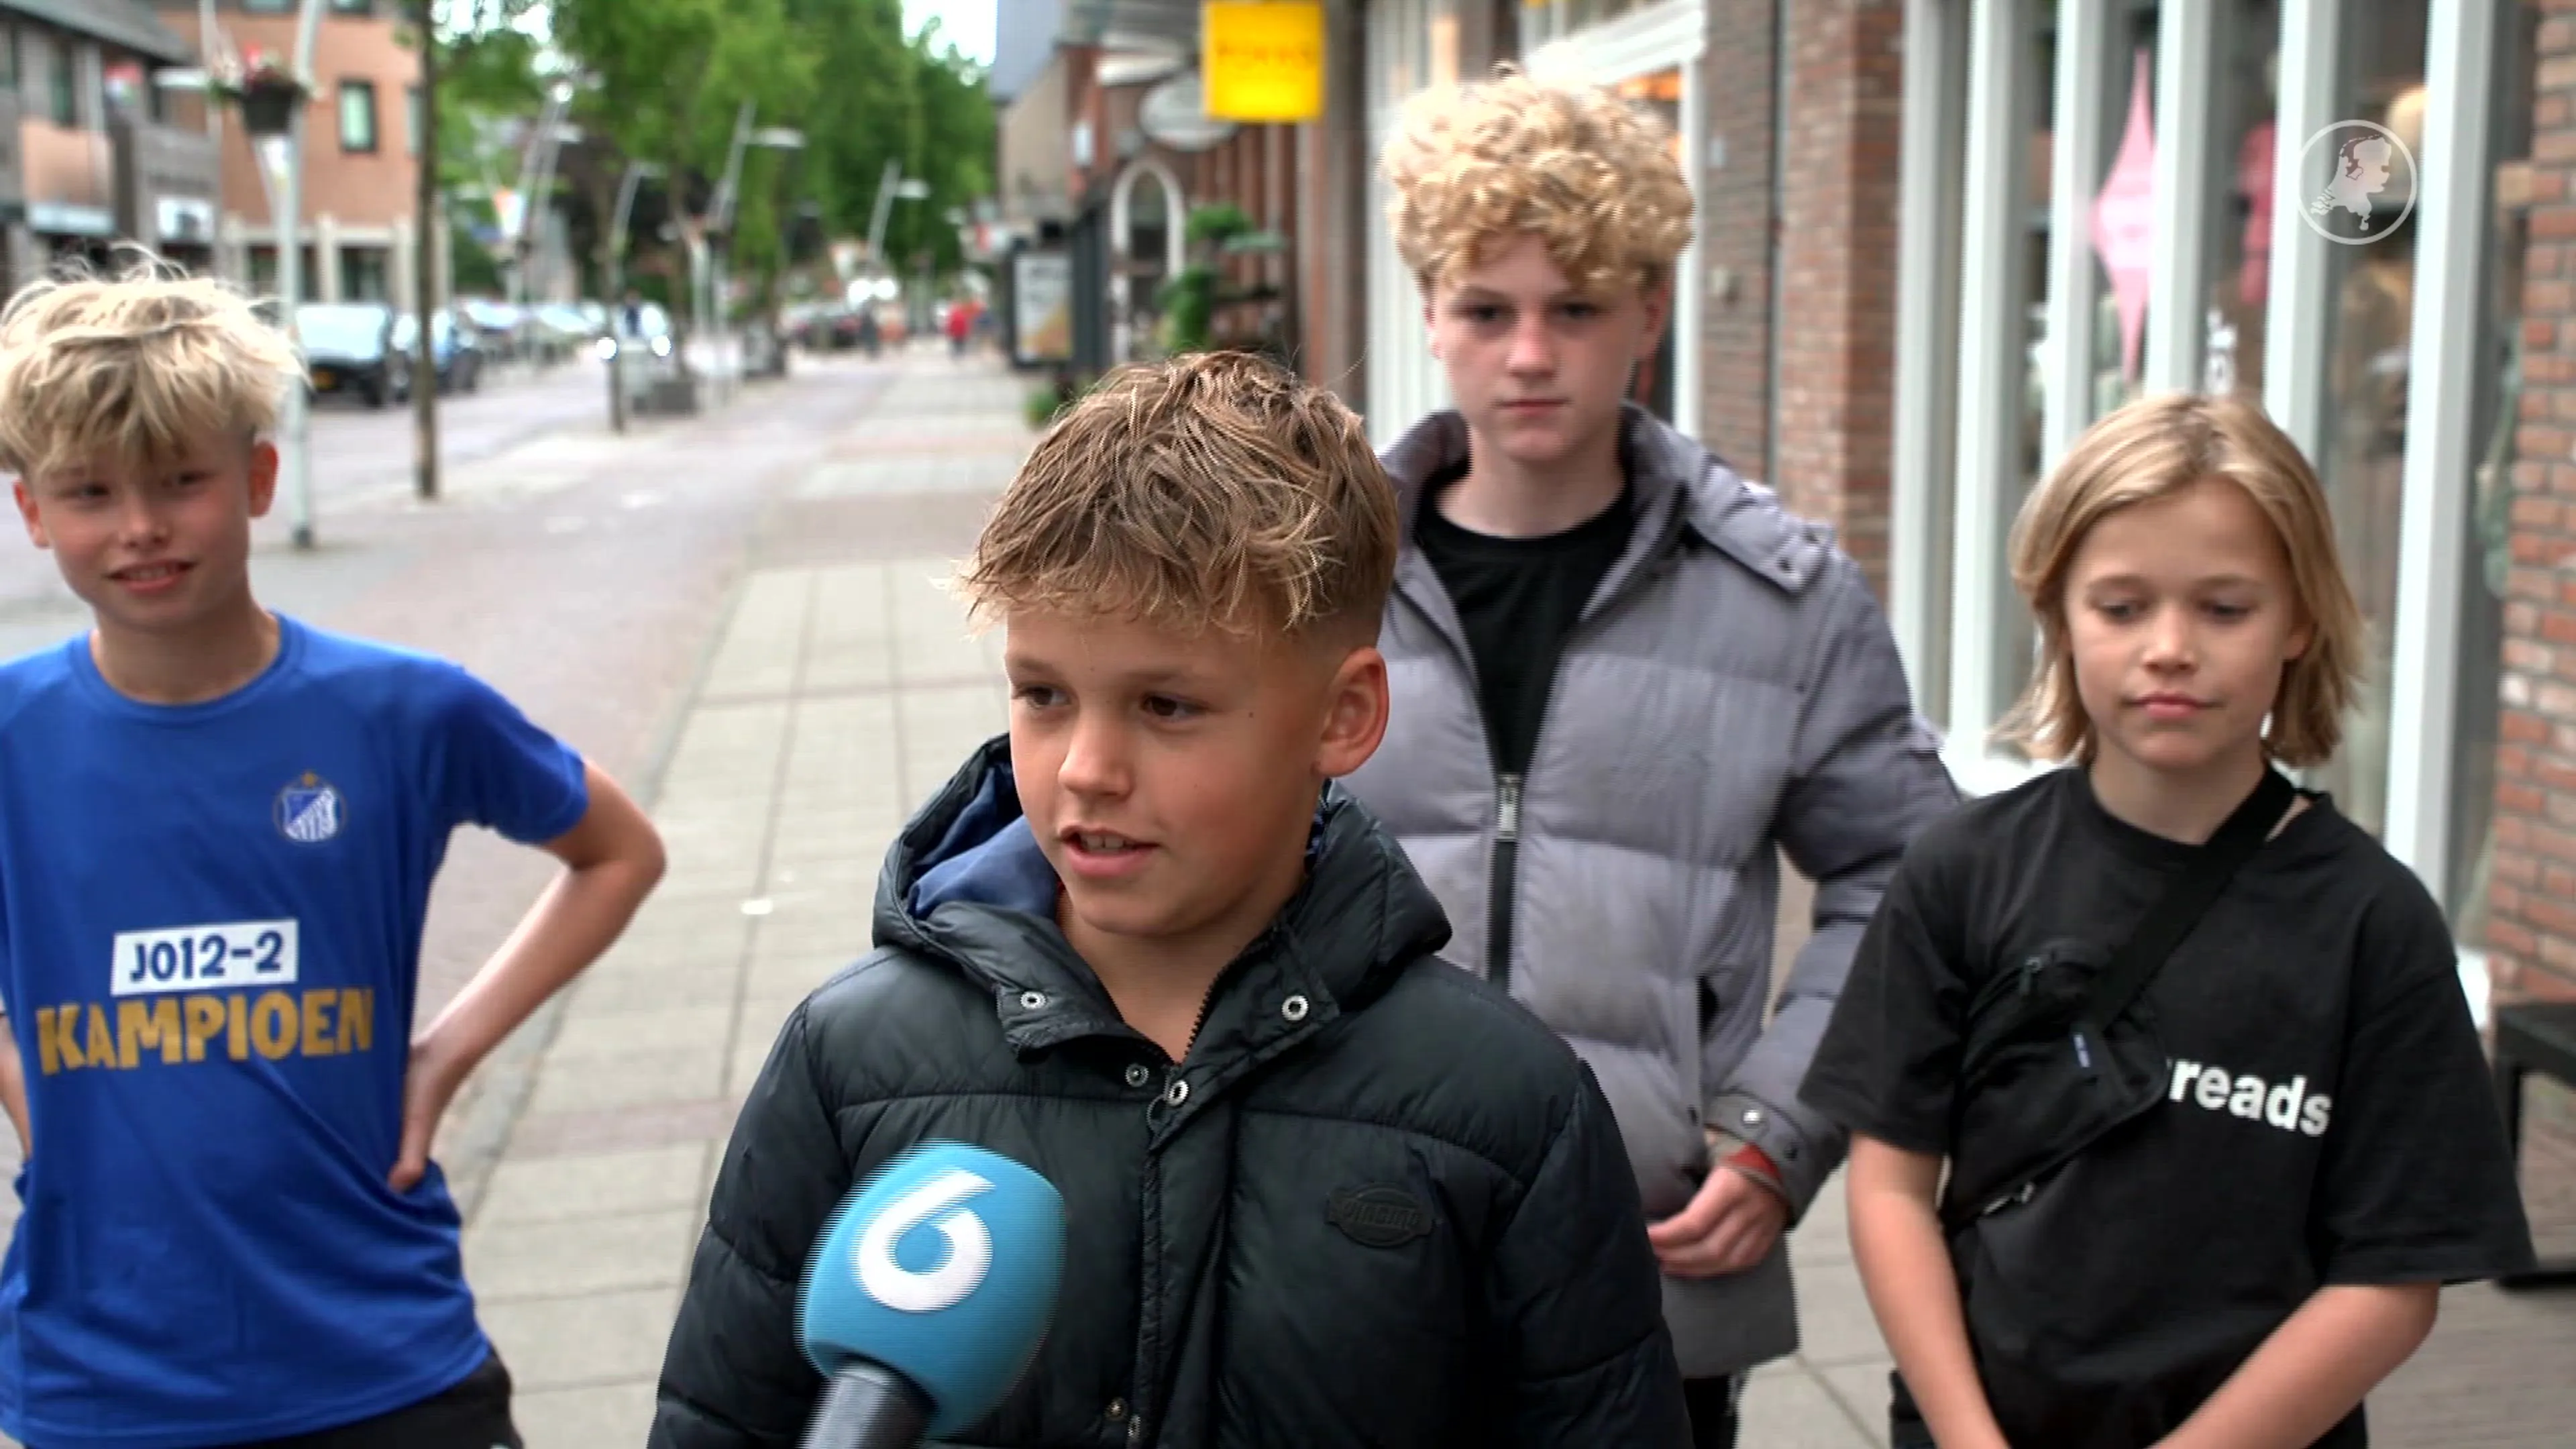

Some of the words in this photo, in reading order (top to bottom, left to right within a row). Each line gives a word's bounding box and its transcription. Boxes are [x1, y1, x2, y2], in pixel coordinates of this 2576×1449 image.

[36, 987, 374, 1075] KAMPIOEN
[2165, 1056, 2332, 1137] reads
[852, 1166, 996, 1313] 6
